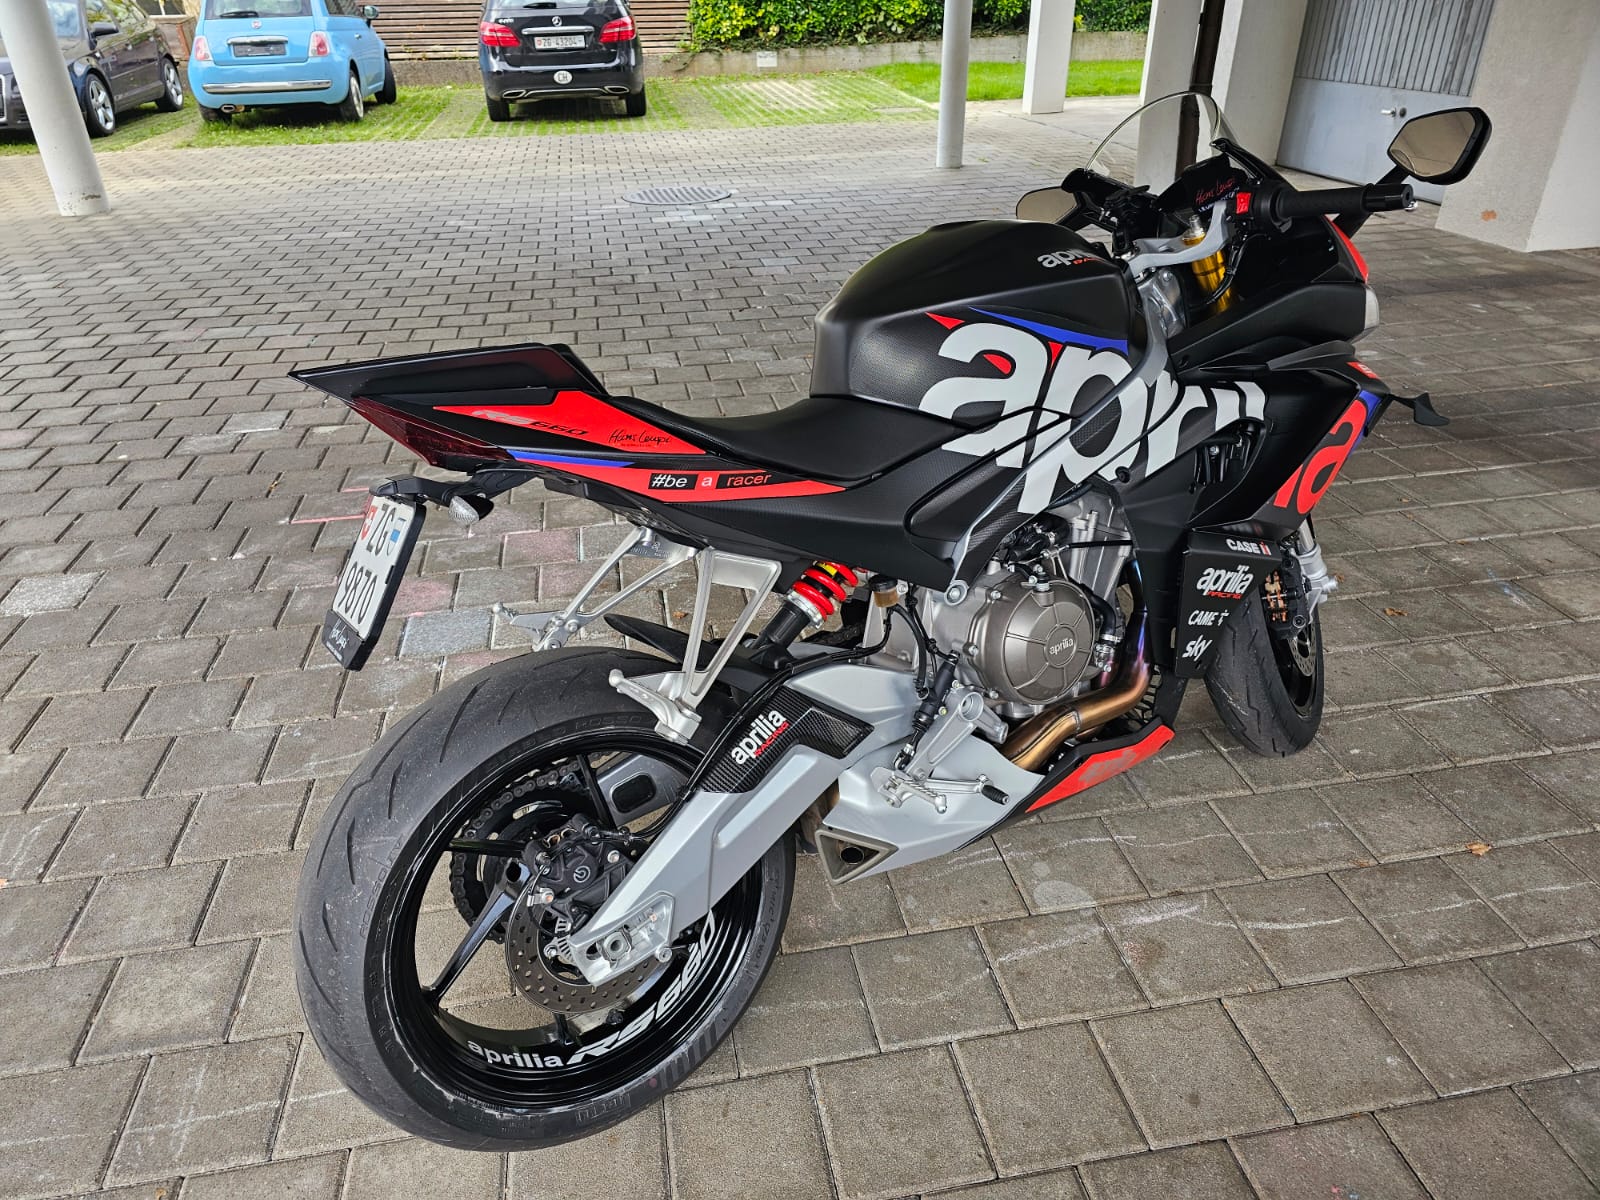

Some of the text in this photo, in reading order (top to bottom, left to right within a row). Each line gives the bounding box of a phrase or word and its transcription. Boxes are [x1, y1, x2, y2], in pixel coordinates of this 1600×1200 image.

[651, 473, 772, 488] #be a racer
[366, 503, 397, 557] ZG
[1226, 538, 1261, 554] CASE
[338, 561, 378, 625] 9870
[1196, 564, 1254, 596] aprilia
[1049, 637, 1074, 655] aprilia
[1182, 634, 1213, 662] sky
[731, 710, 787, 764] aprilia
[467, 1040, 565, 1069] aprilia
